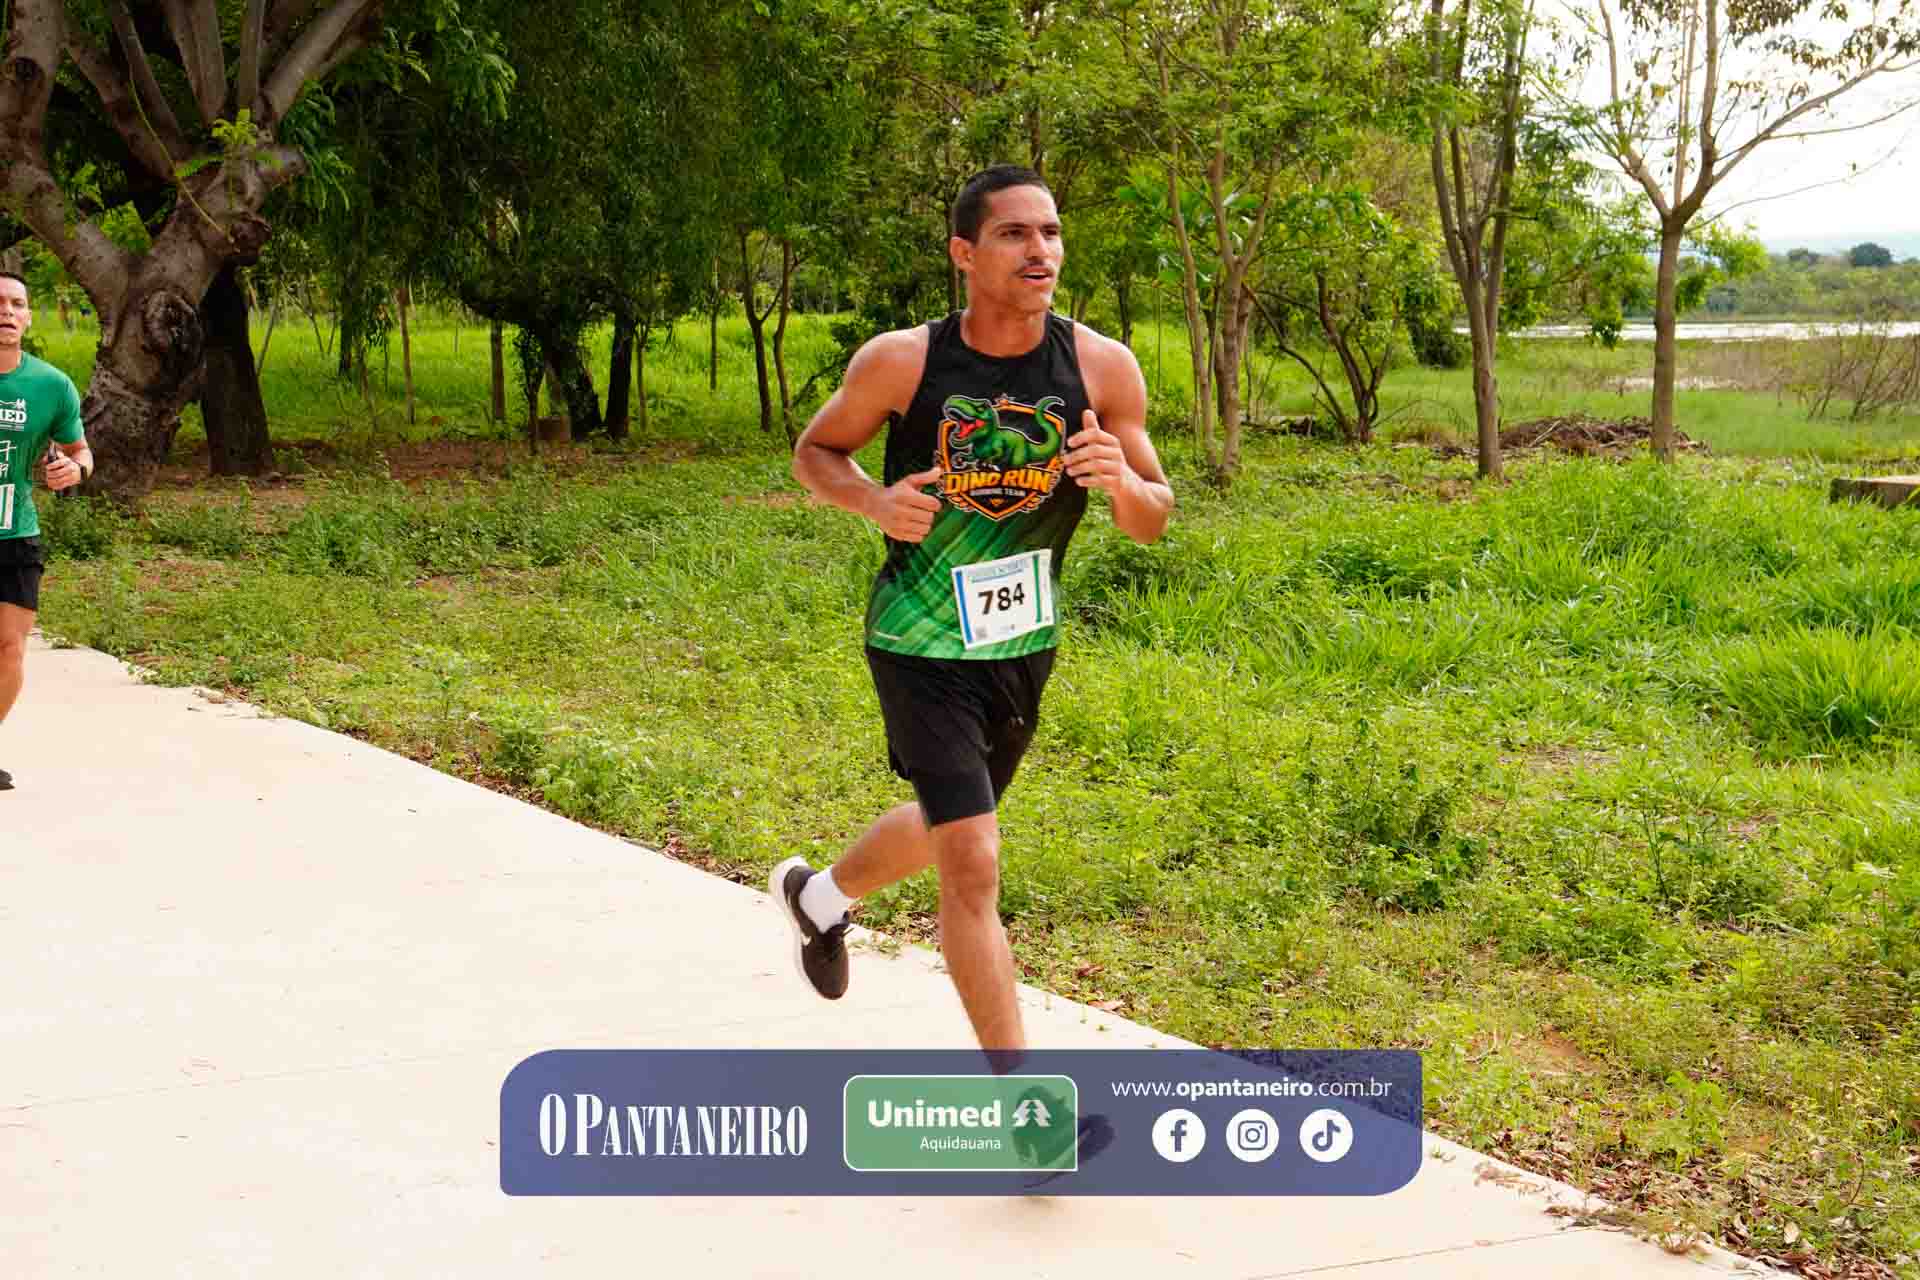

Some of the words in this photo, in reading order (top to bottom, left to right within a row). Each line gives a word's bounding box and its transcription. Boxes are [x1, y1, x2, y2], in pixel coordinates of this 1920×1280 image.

[943, 472, 1002, 495] DINO
[1001, 469, 1051, 494] RUN
[977, 583, 1025, 616] 784
